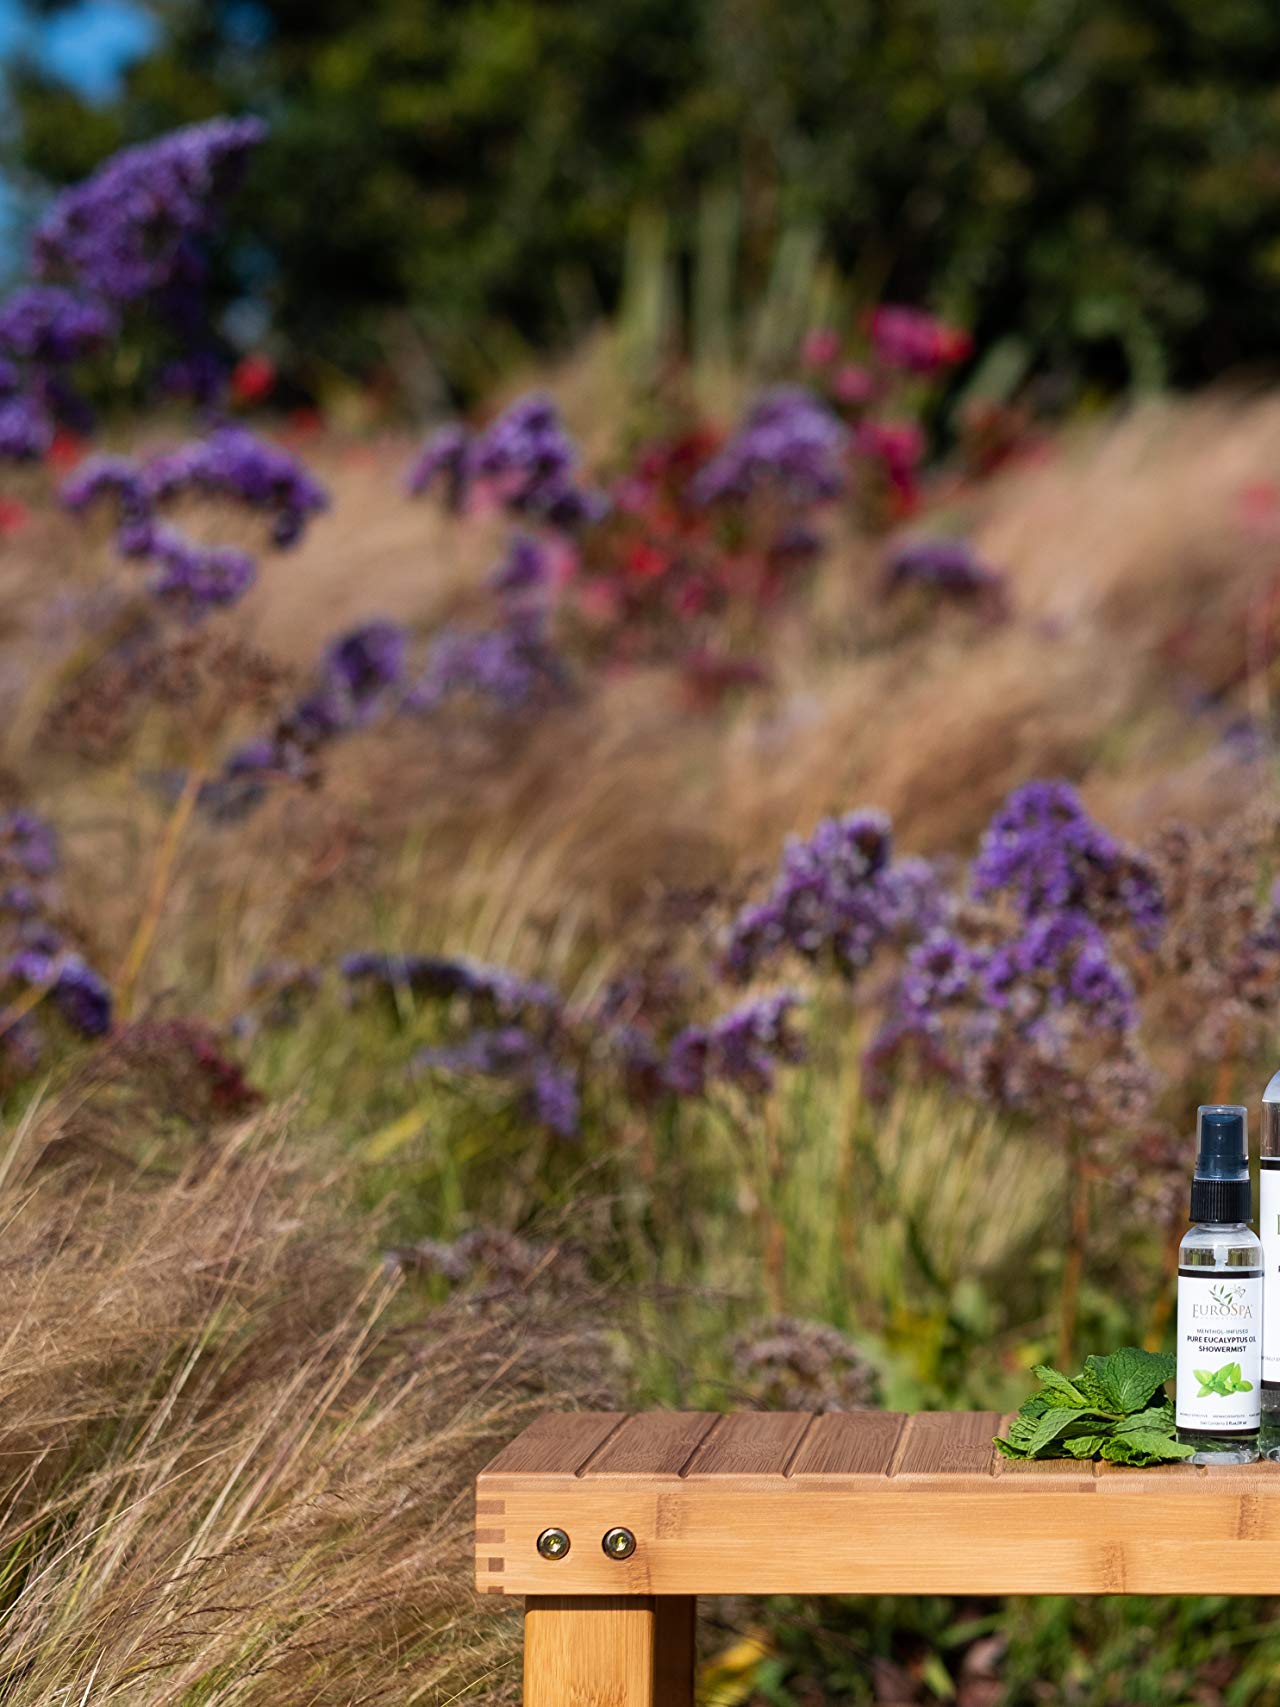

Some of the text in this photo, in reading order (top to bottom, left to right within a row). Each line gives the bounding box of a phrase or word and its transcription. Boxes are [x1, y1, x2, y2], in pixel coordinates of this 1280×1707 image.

[1187, 1335, 1202, 1343] PURE
[1204, 1336, 1248, 1344] EUCALYPTUS
[1199, 1345, 1246, 1353] SHOWERMIST
